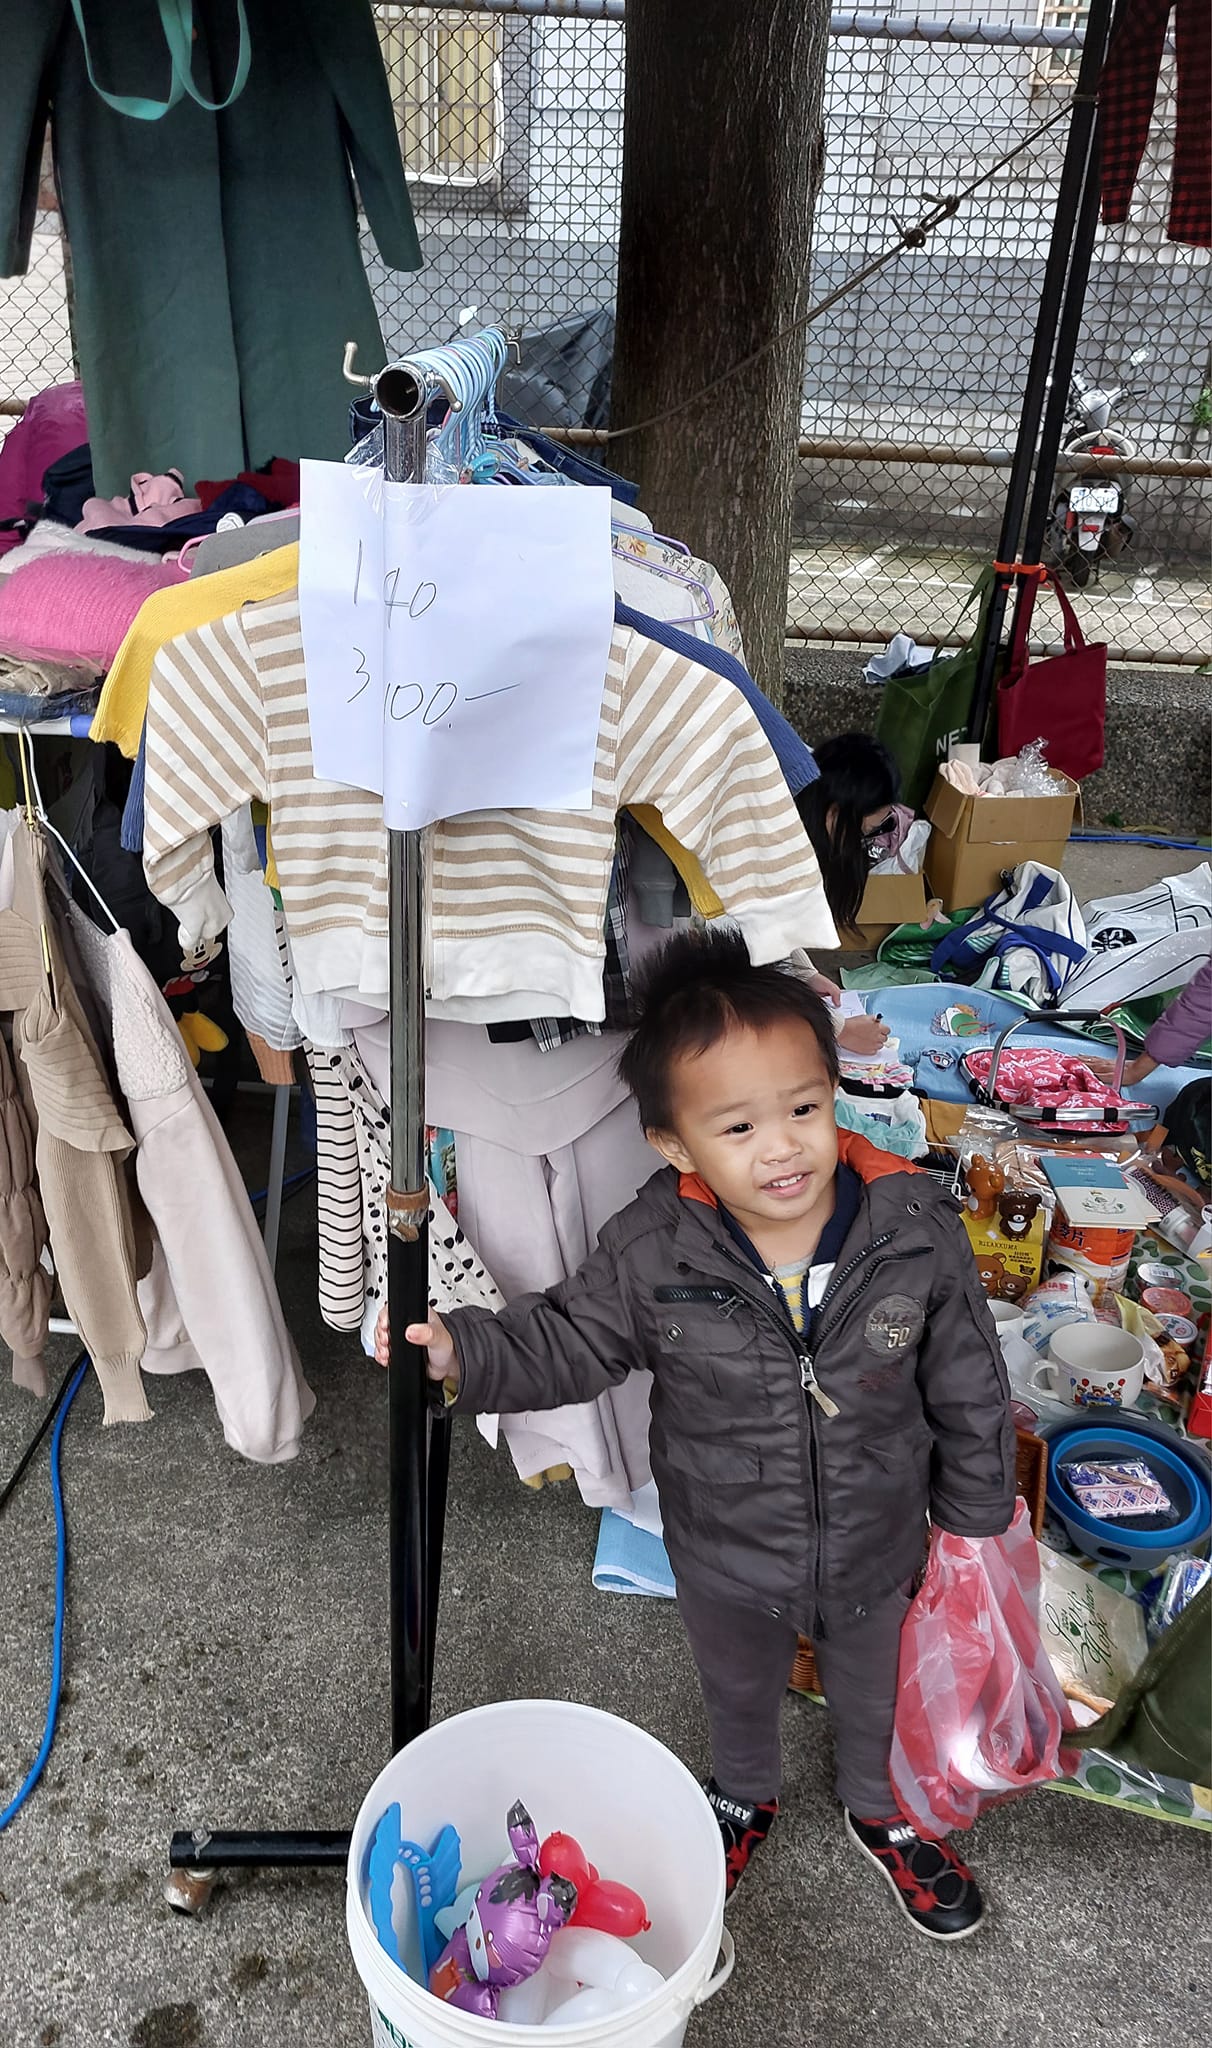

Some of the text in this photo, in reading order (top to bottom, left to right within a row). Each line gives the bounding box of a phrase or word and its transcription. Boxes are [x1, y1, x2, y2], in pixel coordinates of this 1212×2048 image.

[887, 1327, 911, 1349] 50
[708, 1793, 751, 1821] MICKEY
[888, 1825, 917, 1843] MIC
